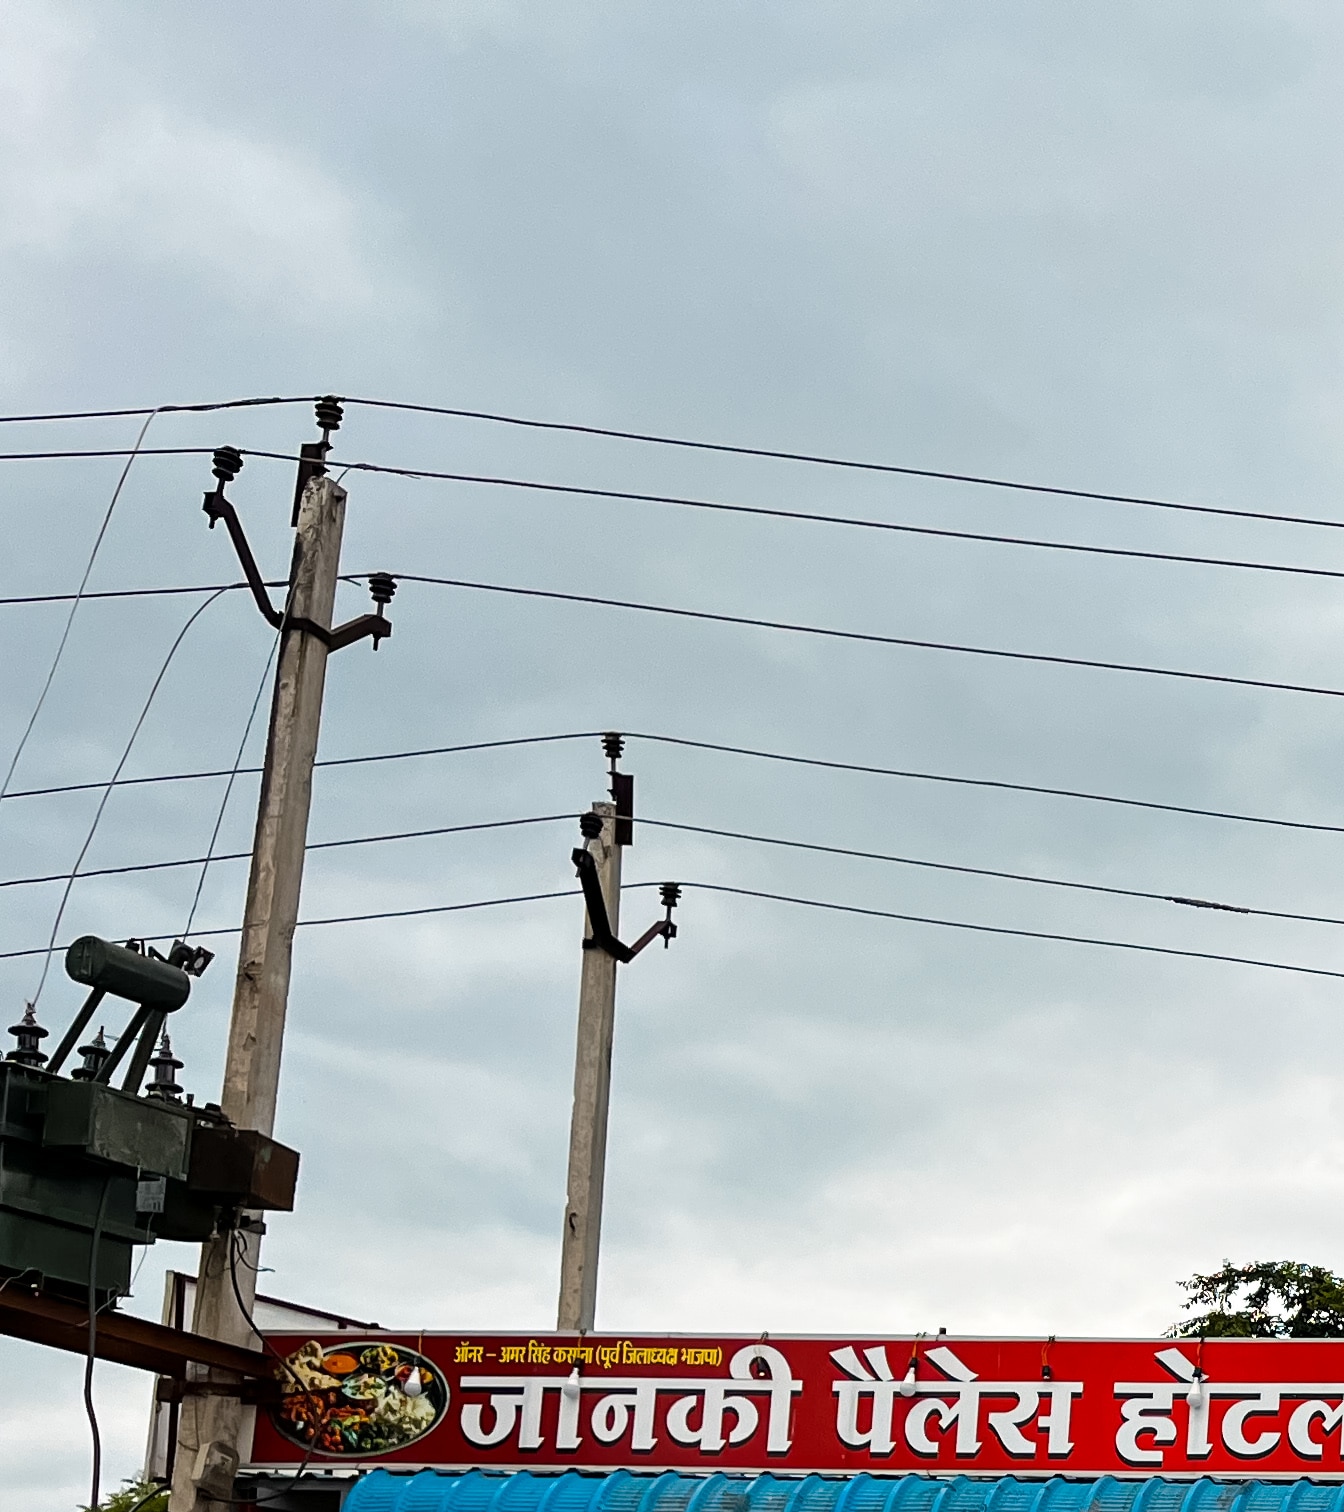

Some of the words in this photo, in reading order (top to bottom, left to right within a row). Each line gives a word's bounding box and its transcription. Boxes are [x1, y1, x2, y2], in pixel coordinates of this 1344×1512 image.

[499, 1346, 525, 1363] अमर
[527, 1340, 550, 1364] सिंह
[459, 1345, 803, 1456] जानकी
[831, 1345, 1083, 1458] पैलेस
